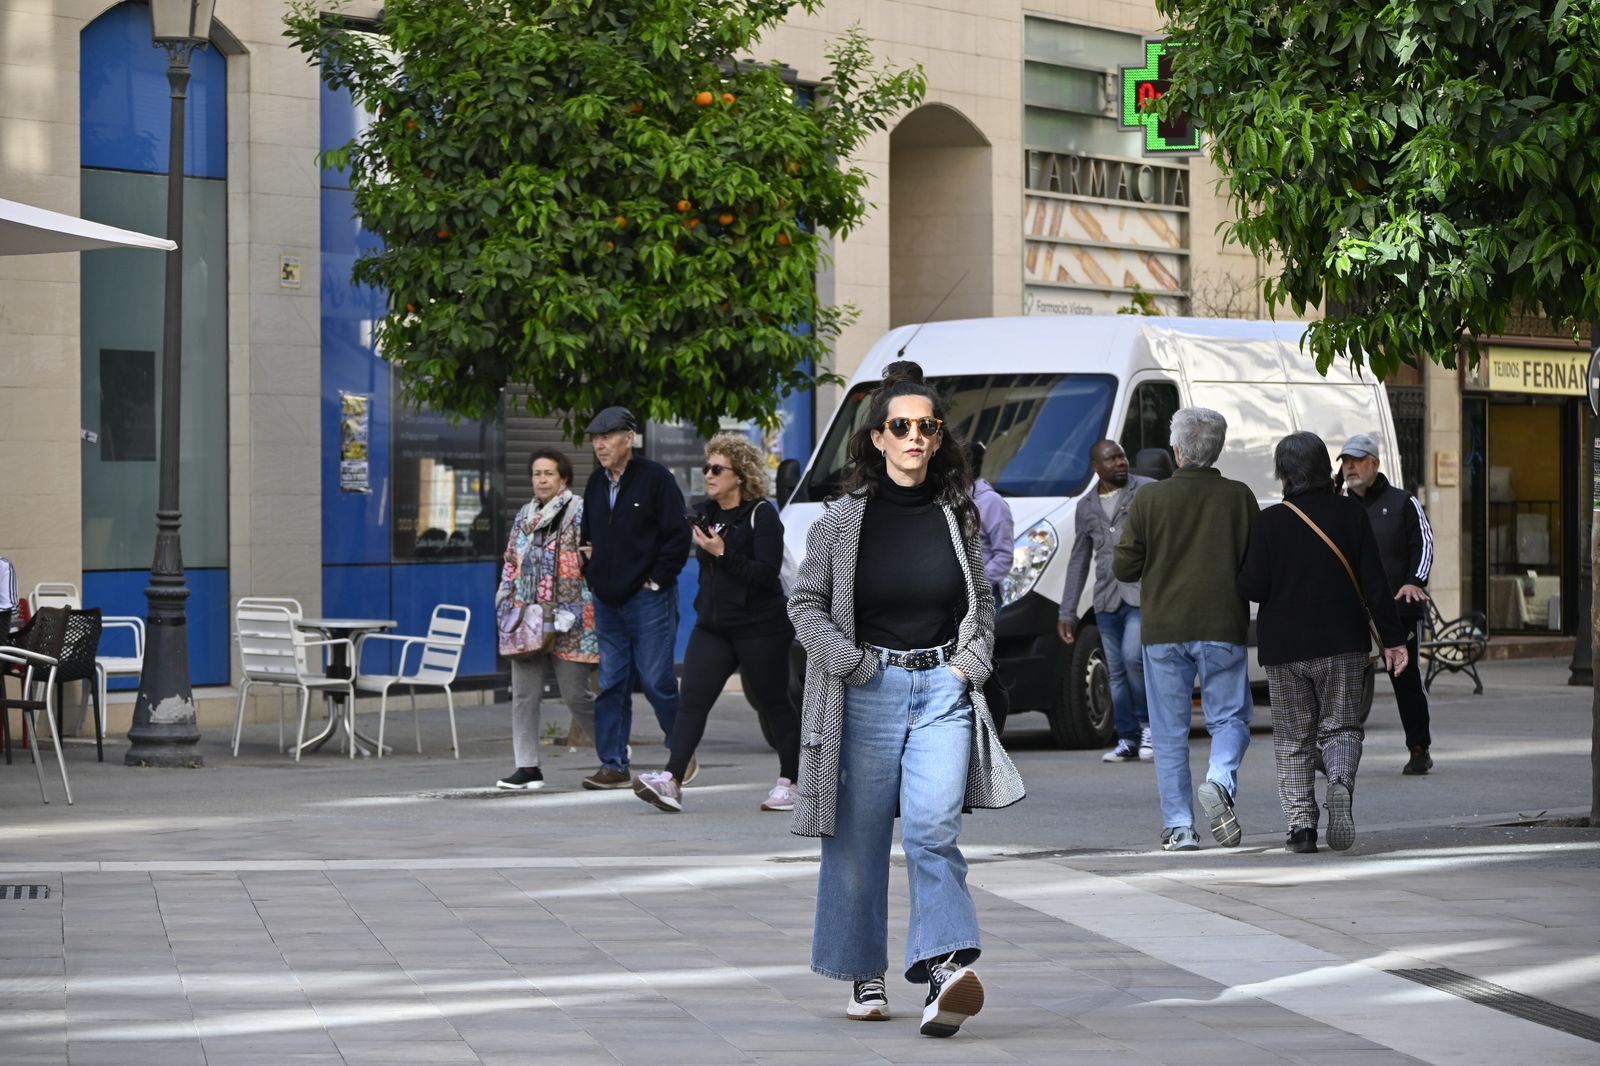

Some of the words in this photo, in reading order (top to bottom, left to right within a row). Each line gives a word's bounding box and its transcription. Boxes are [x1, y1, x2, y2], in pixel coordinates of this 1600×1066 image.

[1029, 150, 1187, 206] FARMACIA
[1036, 299, 1068, 314] Farmacia
[1493, 360, 1520, 378] TEJIDOS
